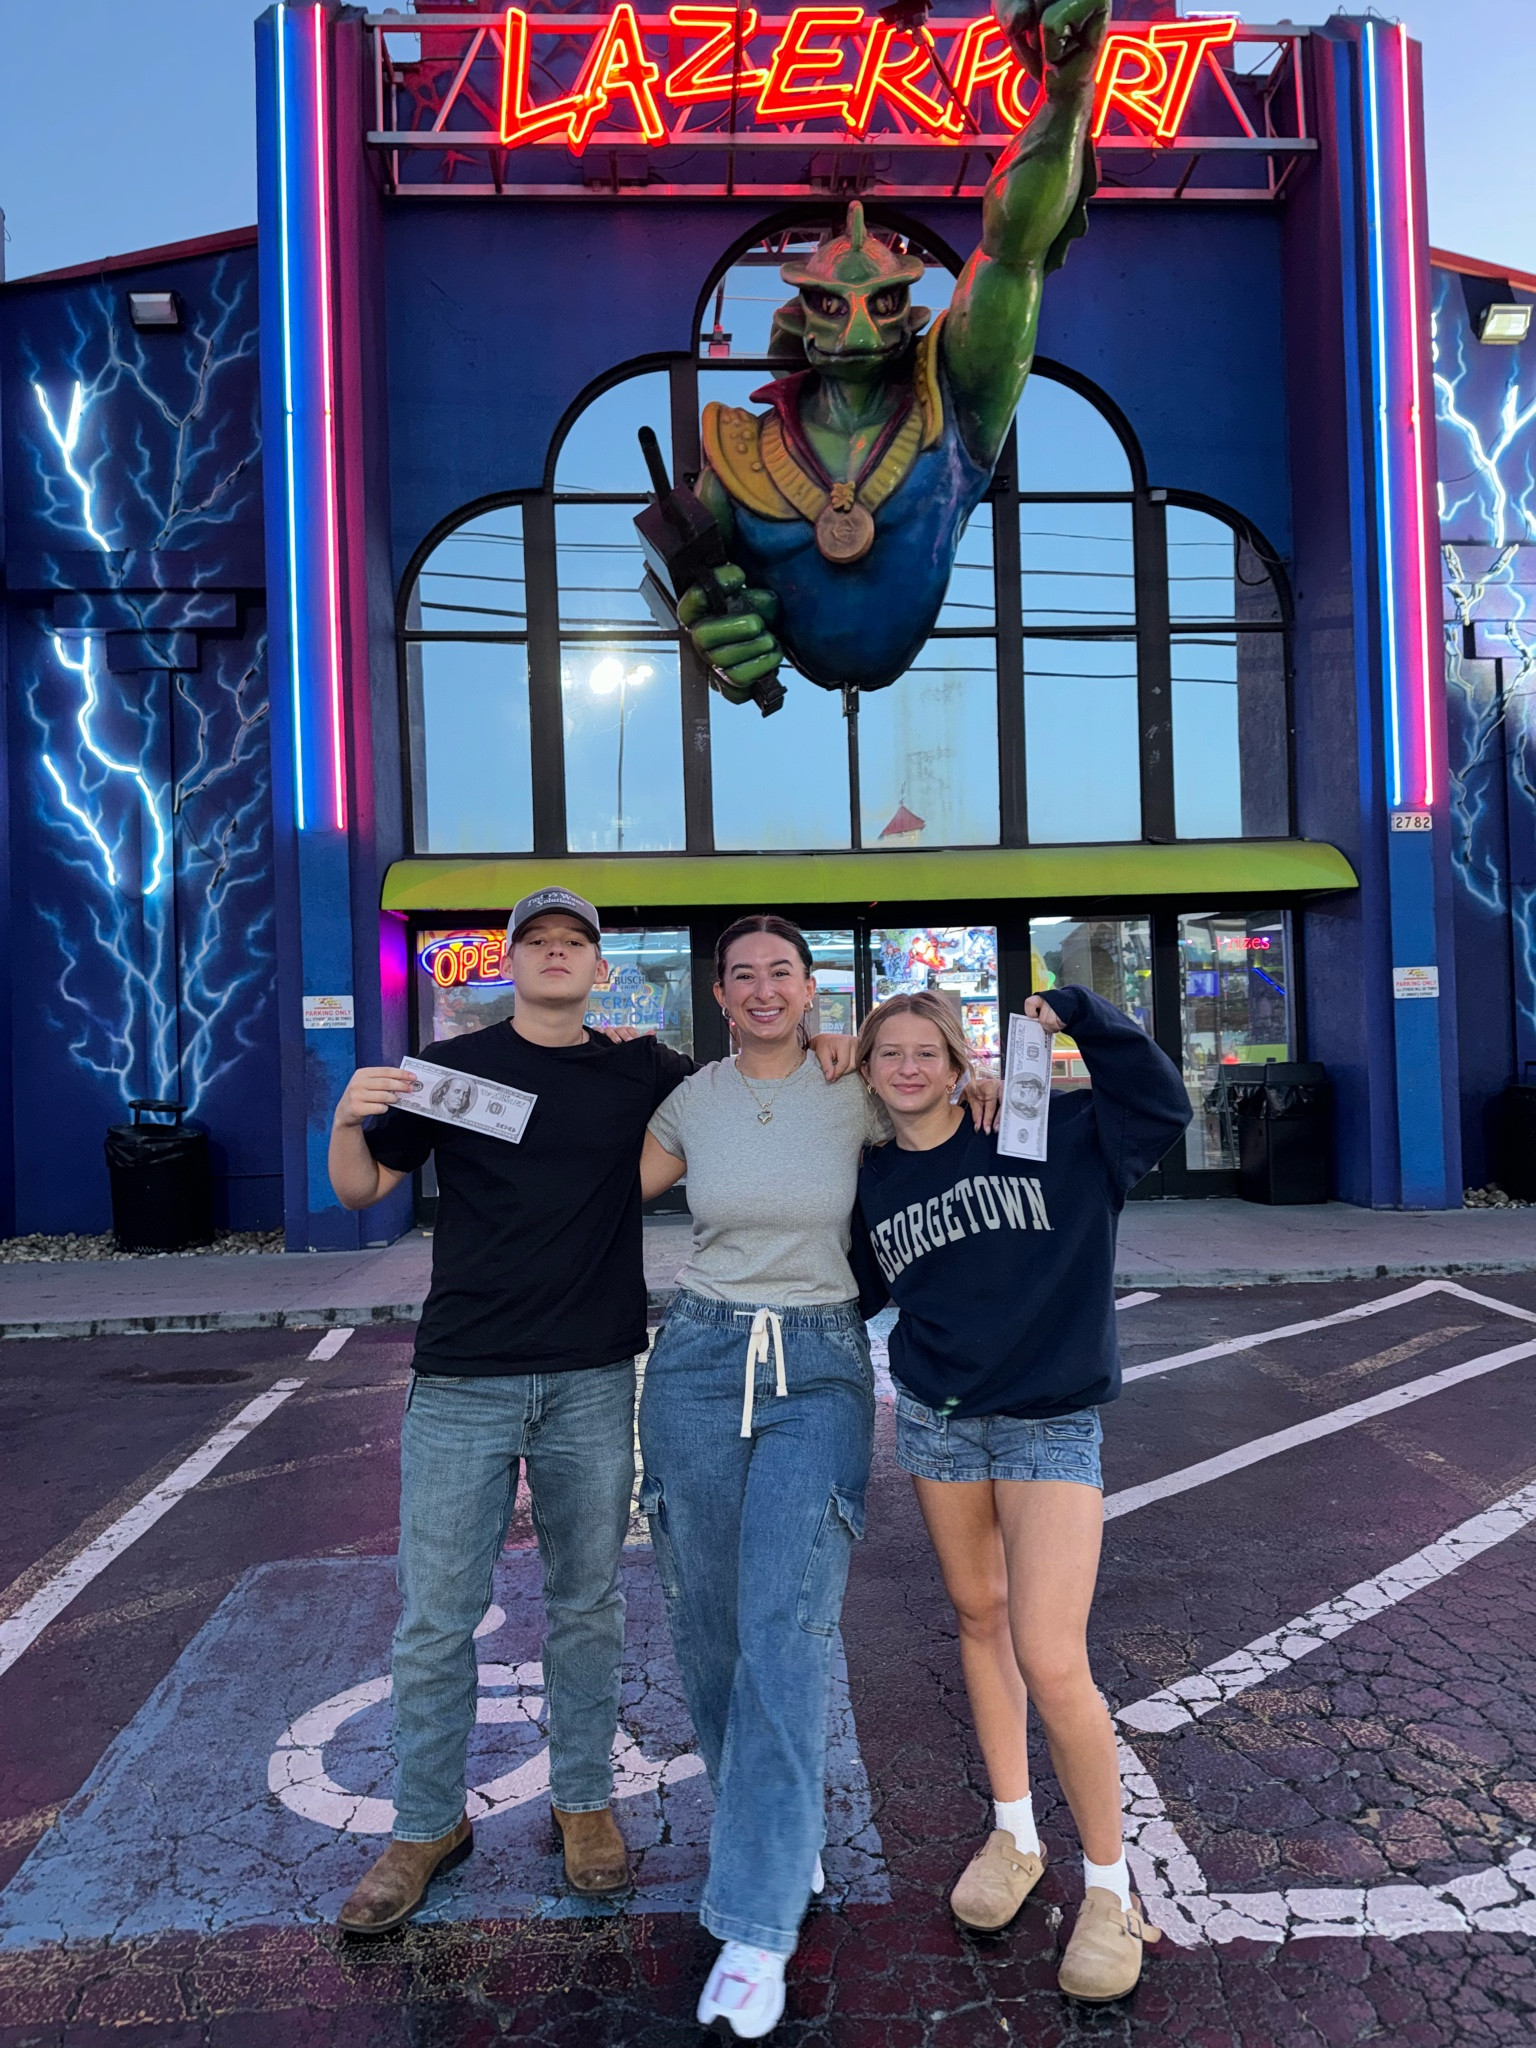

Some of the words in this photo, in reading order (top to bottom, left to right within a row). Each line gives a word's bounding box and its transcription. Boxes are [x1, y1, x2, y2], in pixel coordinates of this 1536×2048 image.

[1396, 816, 1430, 828] 2782
[536, 897, 577, 907] Solutions
[434, 938, 507, 986] OPE
[614, 975, 645, 985] BUSCH
[601, 995, 659, 1010] CRACK
[584, 1012, 622, 1026] ONE
[629, 1010, 679, 1026] OPEN
[869, 1175, 1052, 1284] GEORGETOWN
